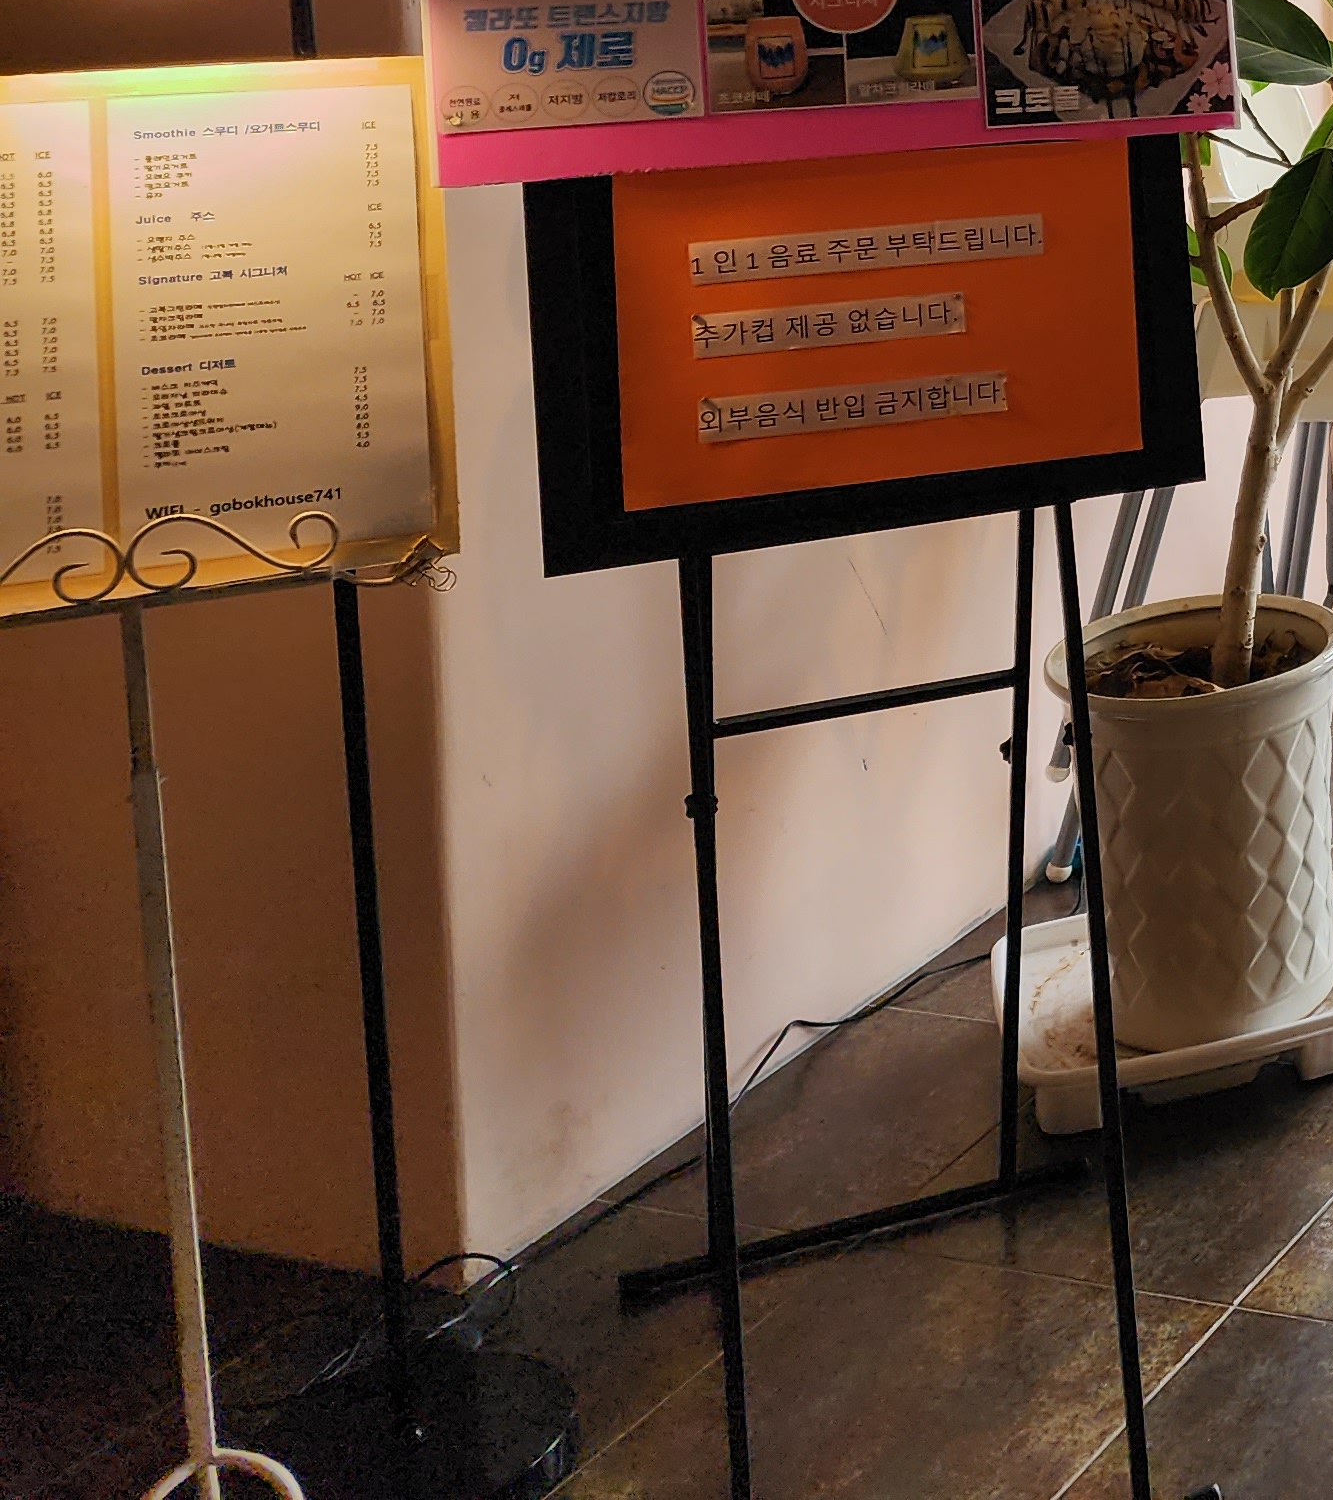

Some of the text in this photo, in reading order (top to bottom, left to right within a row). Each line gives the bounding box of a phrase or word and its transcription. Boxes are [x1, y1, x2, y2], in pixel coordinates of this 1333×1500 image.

[555, 31, 635, 72] 제로
[547, 93, 583, 105] 저지방
[597, 90, 636, 102] 저칼로리
[994, 85, 1080, 115] 크로플
[133, 129, 197, 140] Smoothie
[202, 125, 239, 137] 스무디
[361, 121, 377, 130] ICE
[365, 143, 378, 151] 7.5
[0, 150, 51, 161] OT ICE
[365, 152, 378, 160] 7.5
[366, 161, 379, 169] 7.5
[366, 170, 379, 178] 7.5
[367, 179, 380, 187] 7.5
[135, 203, 383, 225] Juice 주스 ICE
[369, 231, 382, 239] 7.5
[369, 240, 382, 248] 7.5
[690, 222, 1043, 276] 1 인 1 음료 주문 부탁드립니다.
[138, 265, 384, 287] Signature 고복 시그니처 HOT ICE
[693, 300, 959, 349] 추가컵 제공 없습니다.
[141, 358, 236, 376] Dessert 디저트
[354, 366, 367, 374] 7.5
[354, 375, 367, 384] 7.5
[355, 385, 368, 393] 7.5
[698, 378, 1007, 434] 외부음식 반입 금지합니다.
[209, 488, 342, 516] gobokhouse741
